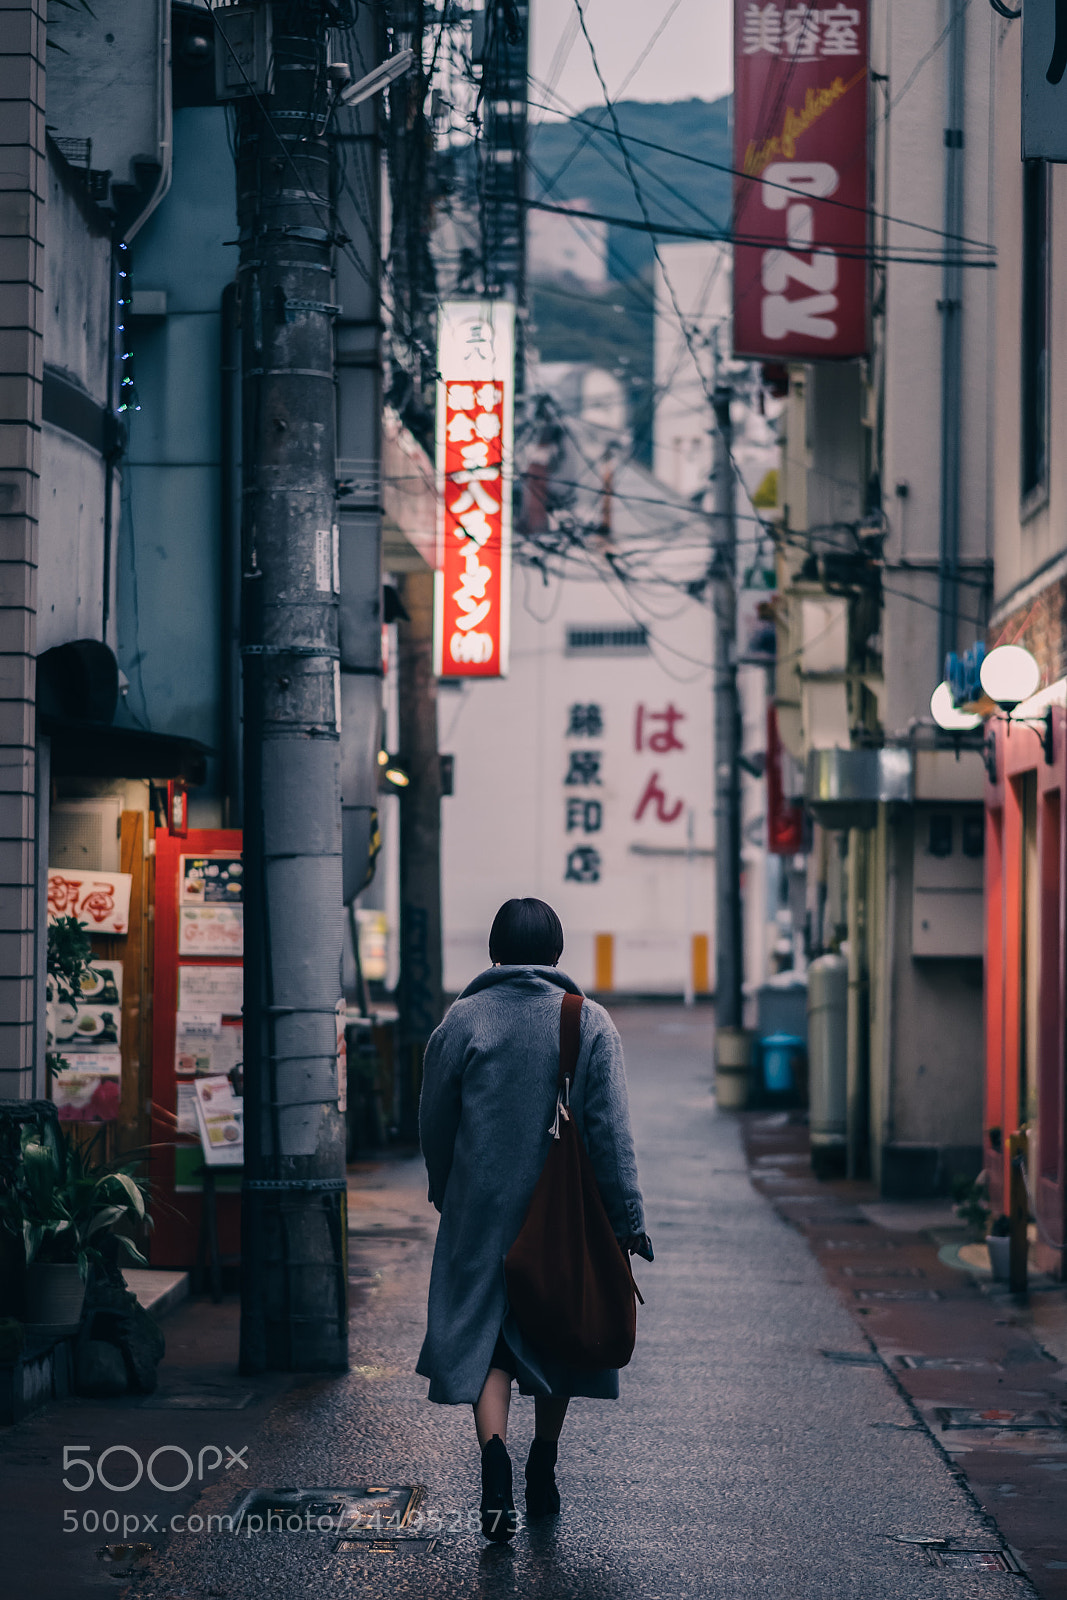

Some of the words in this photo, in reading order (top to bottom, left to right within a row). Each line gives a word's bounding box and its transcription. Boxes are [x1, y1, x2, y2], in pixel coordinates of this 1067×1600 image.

[743, 2, 861, 56] 美容室
[634, 700, 686, 823] はん
